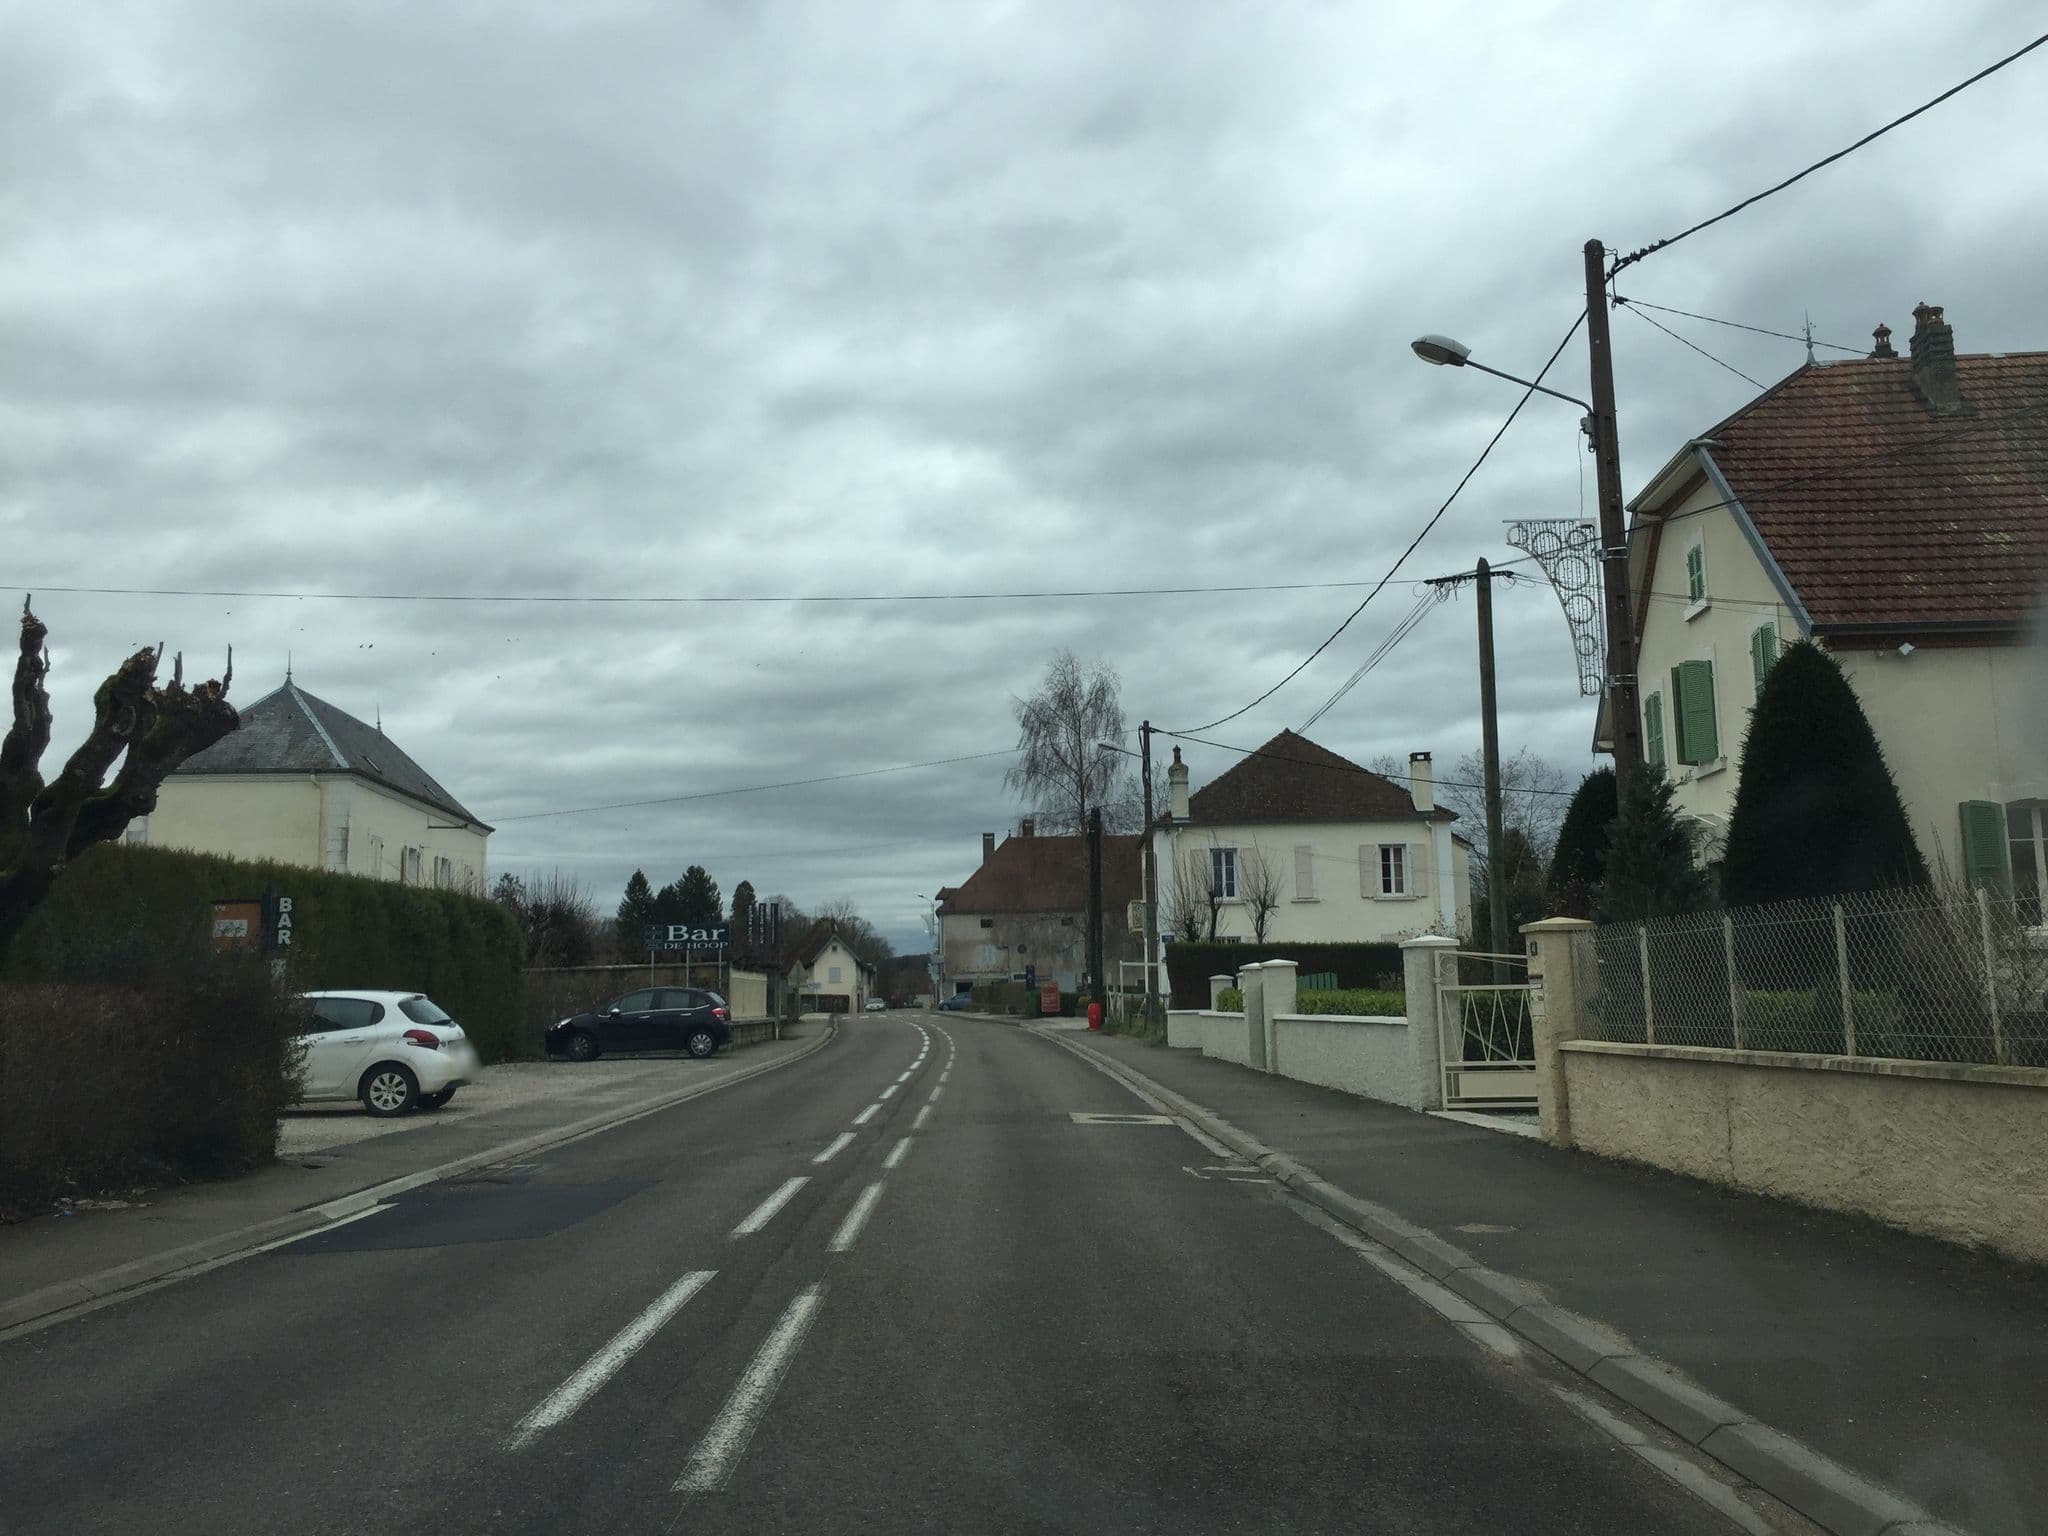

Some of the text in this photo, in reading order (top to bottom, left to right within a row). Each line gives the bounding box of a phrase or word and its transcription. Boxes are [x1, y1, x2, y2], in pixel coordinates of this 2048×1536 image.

[277, 897, 293, 945] BAR
[667, 925, 726, 941] Bar
[664, 942, 729, 950] DE HOOP
